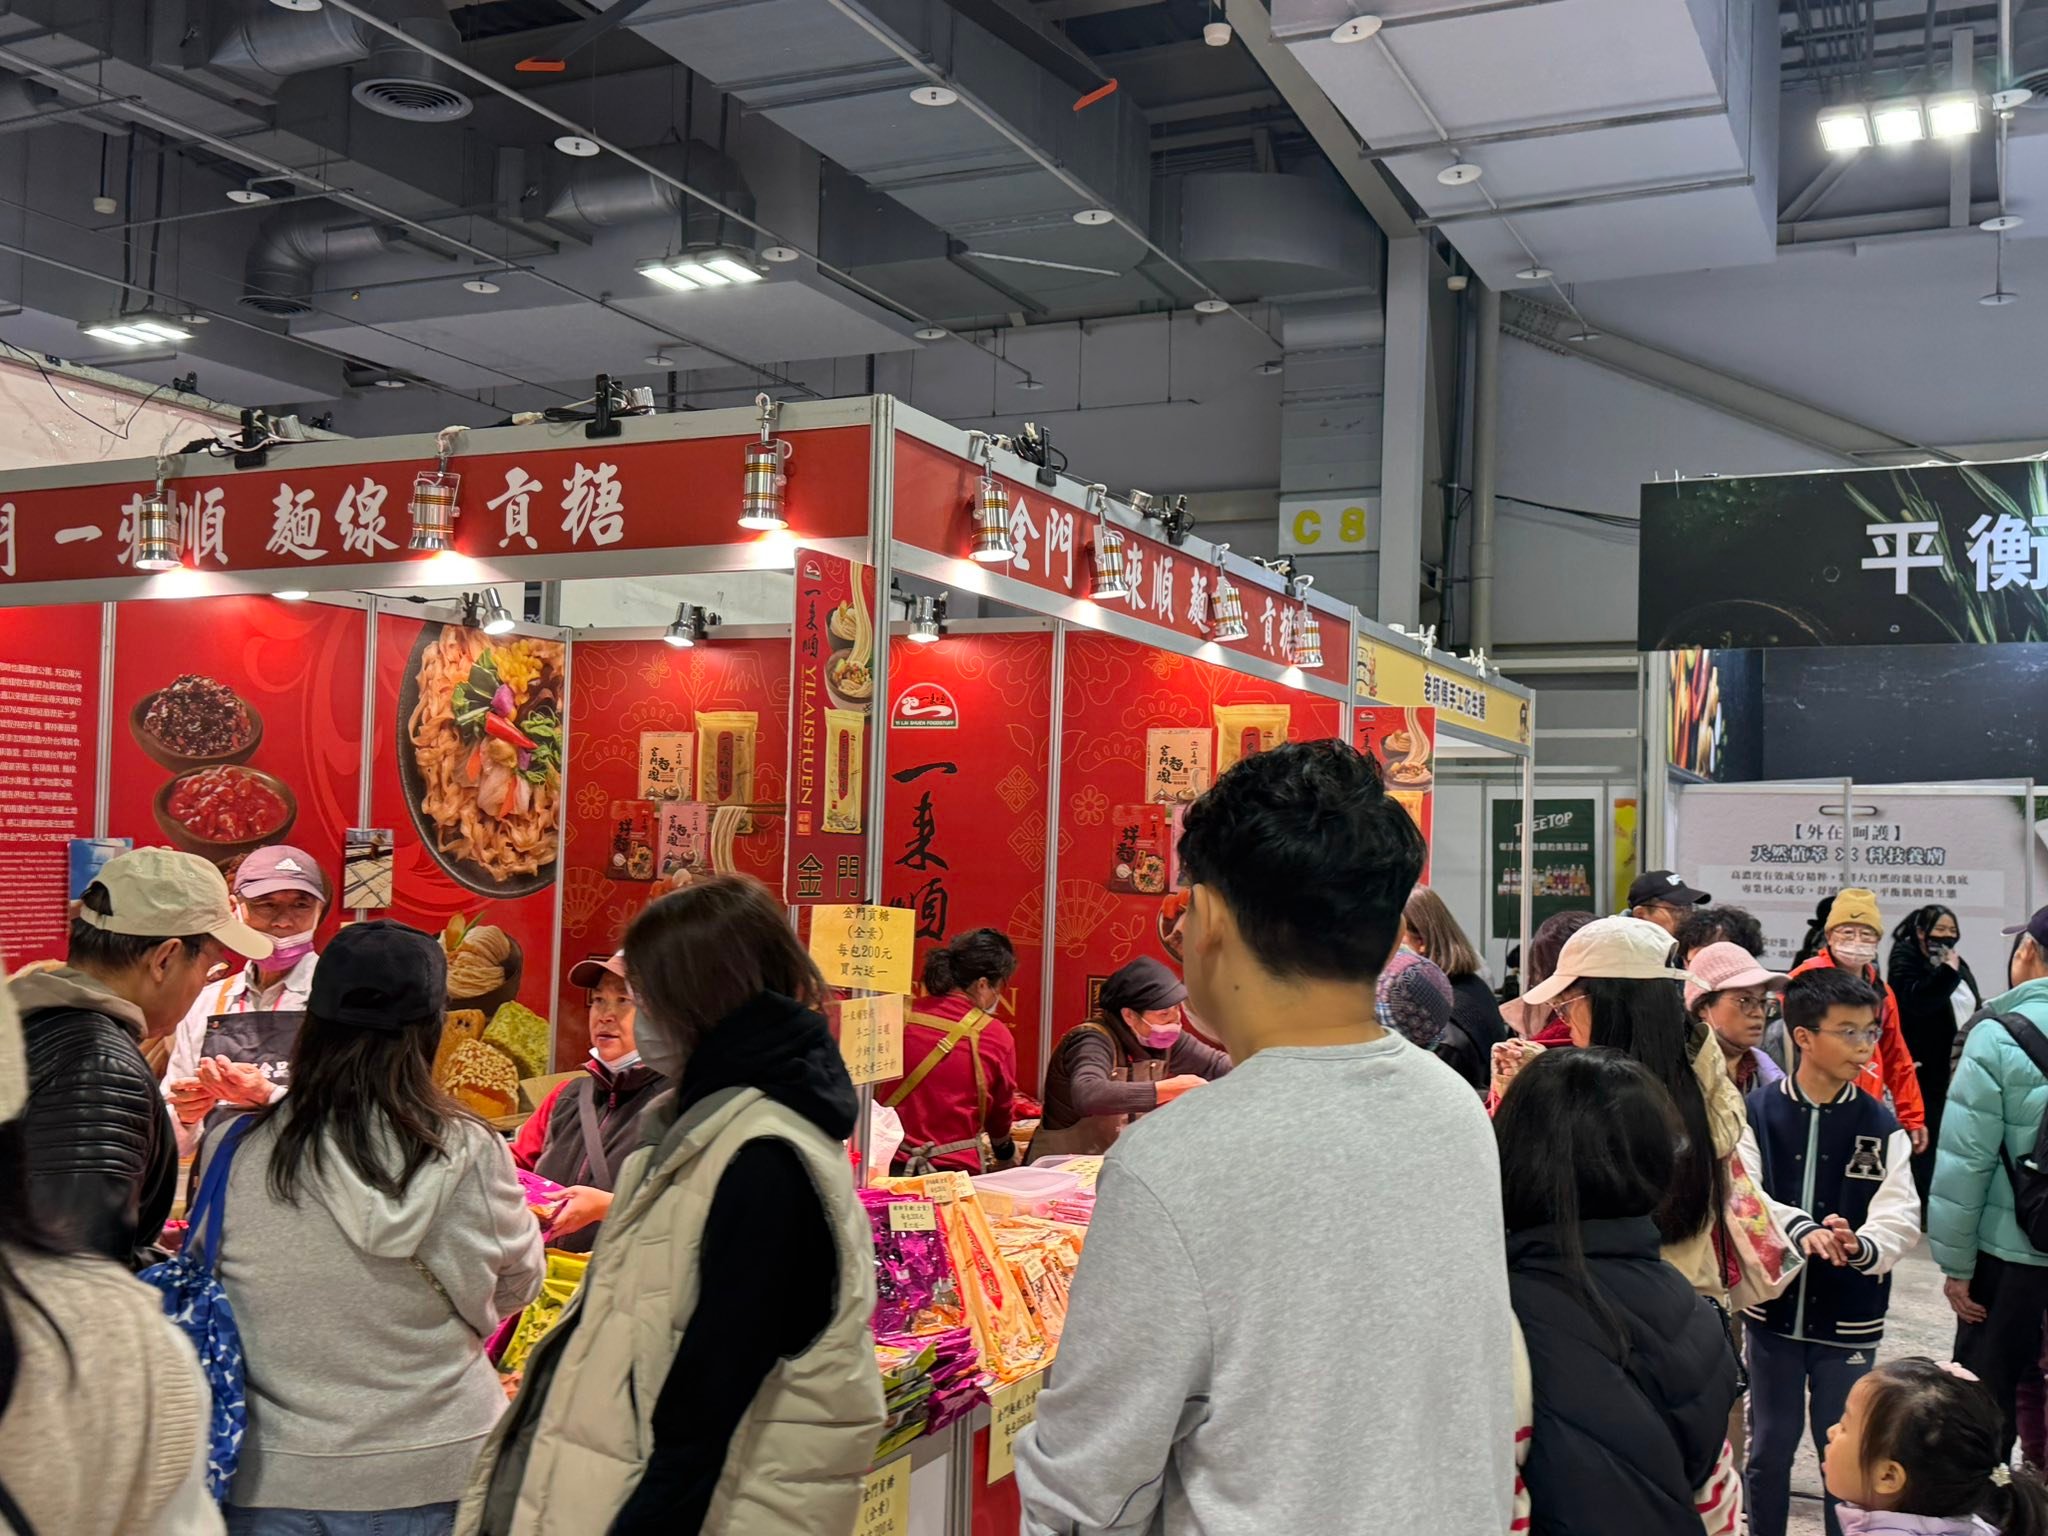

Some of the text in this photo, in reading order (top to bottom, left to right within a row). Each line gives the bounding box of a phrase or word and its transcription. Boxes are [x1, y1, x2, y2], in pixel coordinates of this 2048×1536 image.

[266, 477, 399, 562] 麵線
[487, 462, 625, 549] 貢糖
[1009, 497, 1073, 589] 金門
[1125, 542, 1175, 623] 來順
[796, 853, 861, 899] 金門
[843, 906, 891, 921] 金門貢糖
[841, 963, 889, 978] 買六送一
